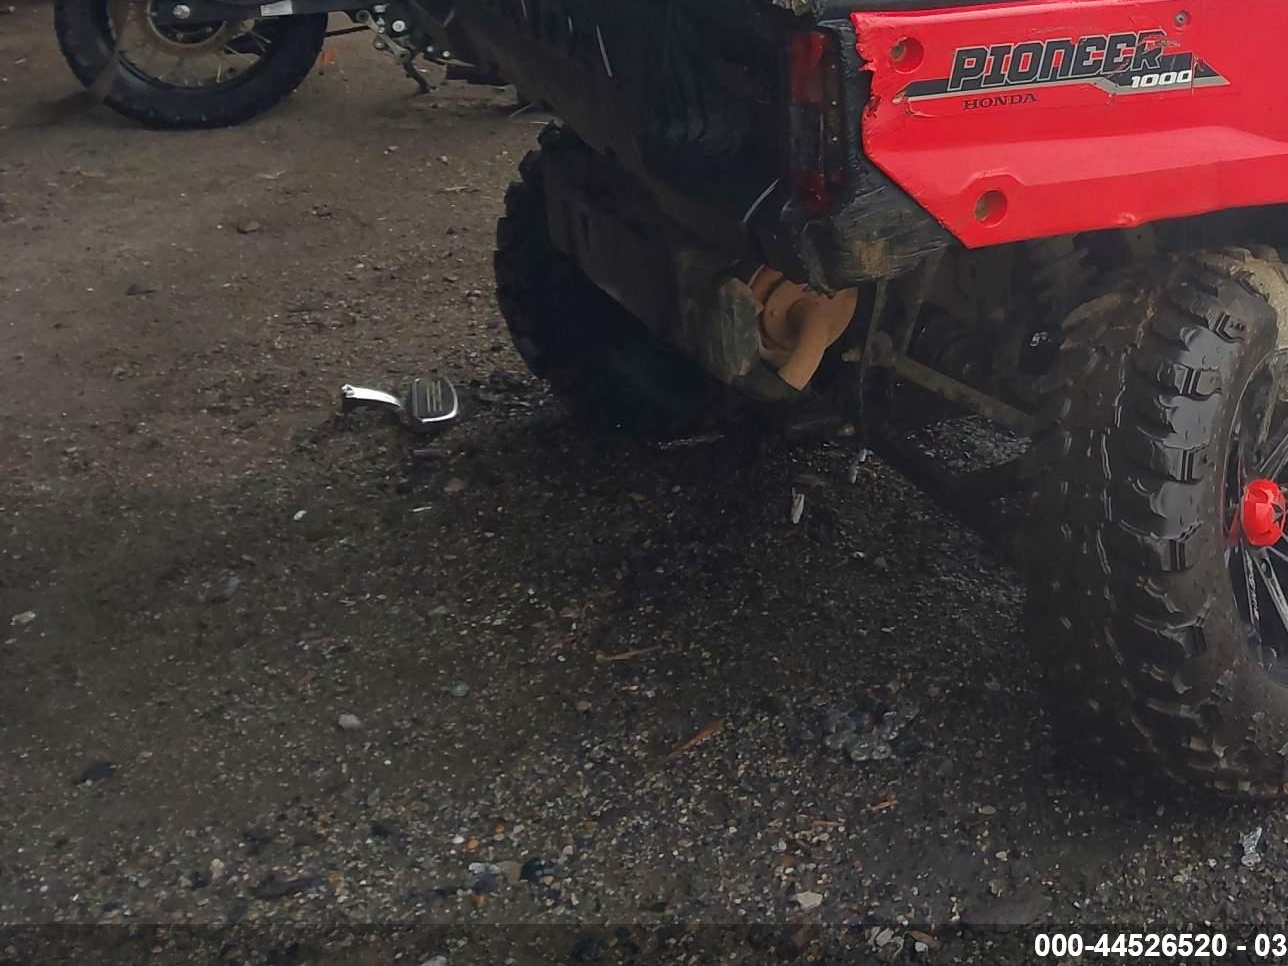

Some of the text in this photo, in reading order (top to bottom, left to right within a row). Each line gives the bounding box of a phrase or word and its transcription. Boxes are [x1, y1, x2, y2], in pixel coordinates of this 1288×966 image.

[946, 29, 1168, 92] PIONEER
[1131, 69, 1193, 89] 1000
[963, 93, 1038, 111] HONDA
